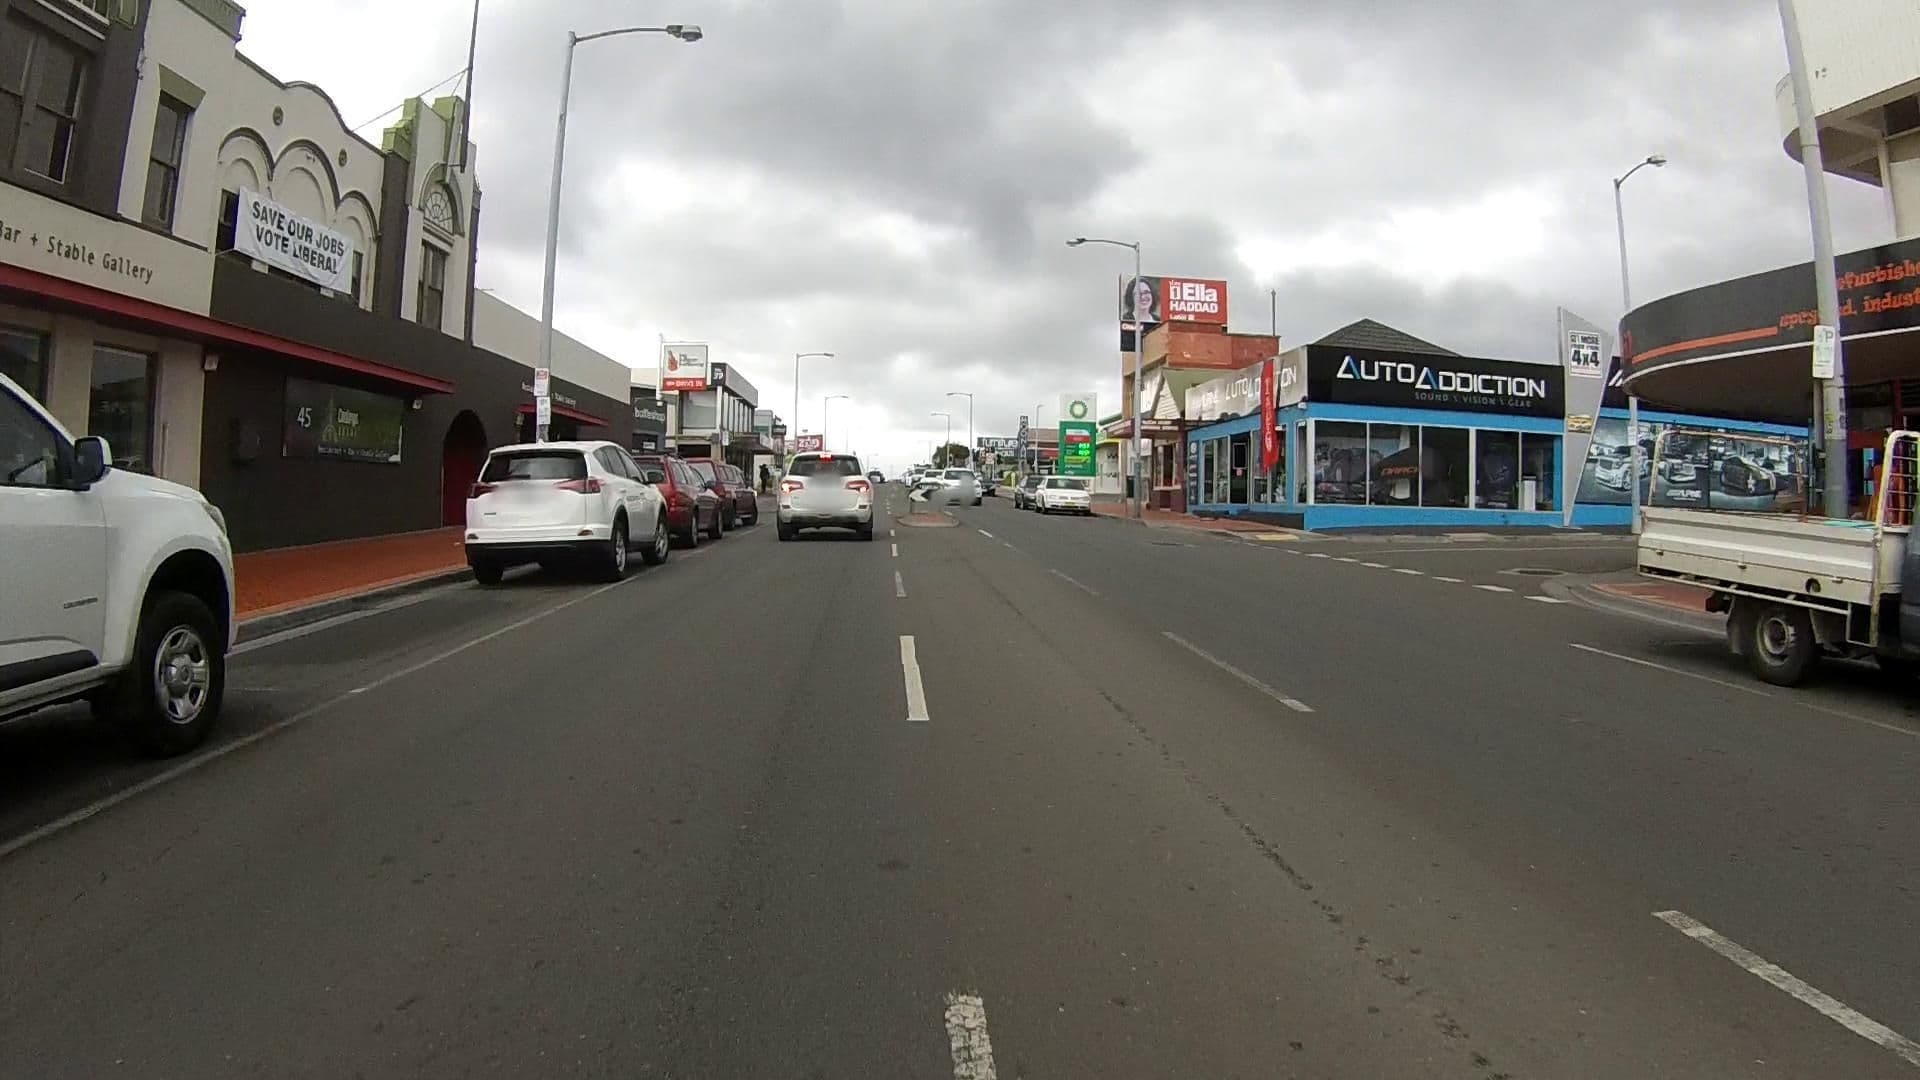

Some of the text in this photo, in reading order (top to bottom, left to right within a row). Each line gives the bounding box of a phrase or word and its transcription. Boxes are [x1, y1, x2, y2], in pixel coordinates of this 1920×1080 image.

[252, 200, 344, 257] SAVE OUR JOBS
[46, 235, 95, 265] Stable
[102, 252, 153, 285] Gallery
[255, 223, 338, 275] VOTE LIBERAL
[1169, 300, 1218, 313] HADDAD
[1182, 282, 1218, 302] Ella
[1336, 355, 1546, 399] AUTOADDICTION
[1414, 391, 1449, 401] SOUND
[1462, 394, 1496, 406] VISION
[1507, 399, 1532, 408] GEAR
[297, 406, 312, 428] 45
